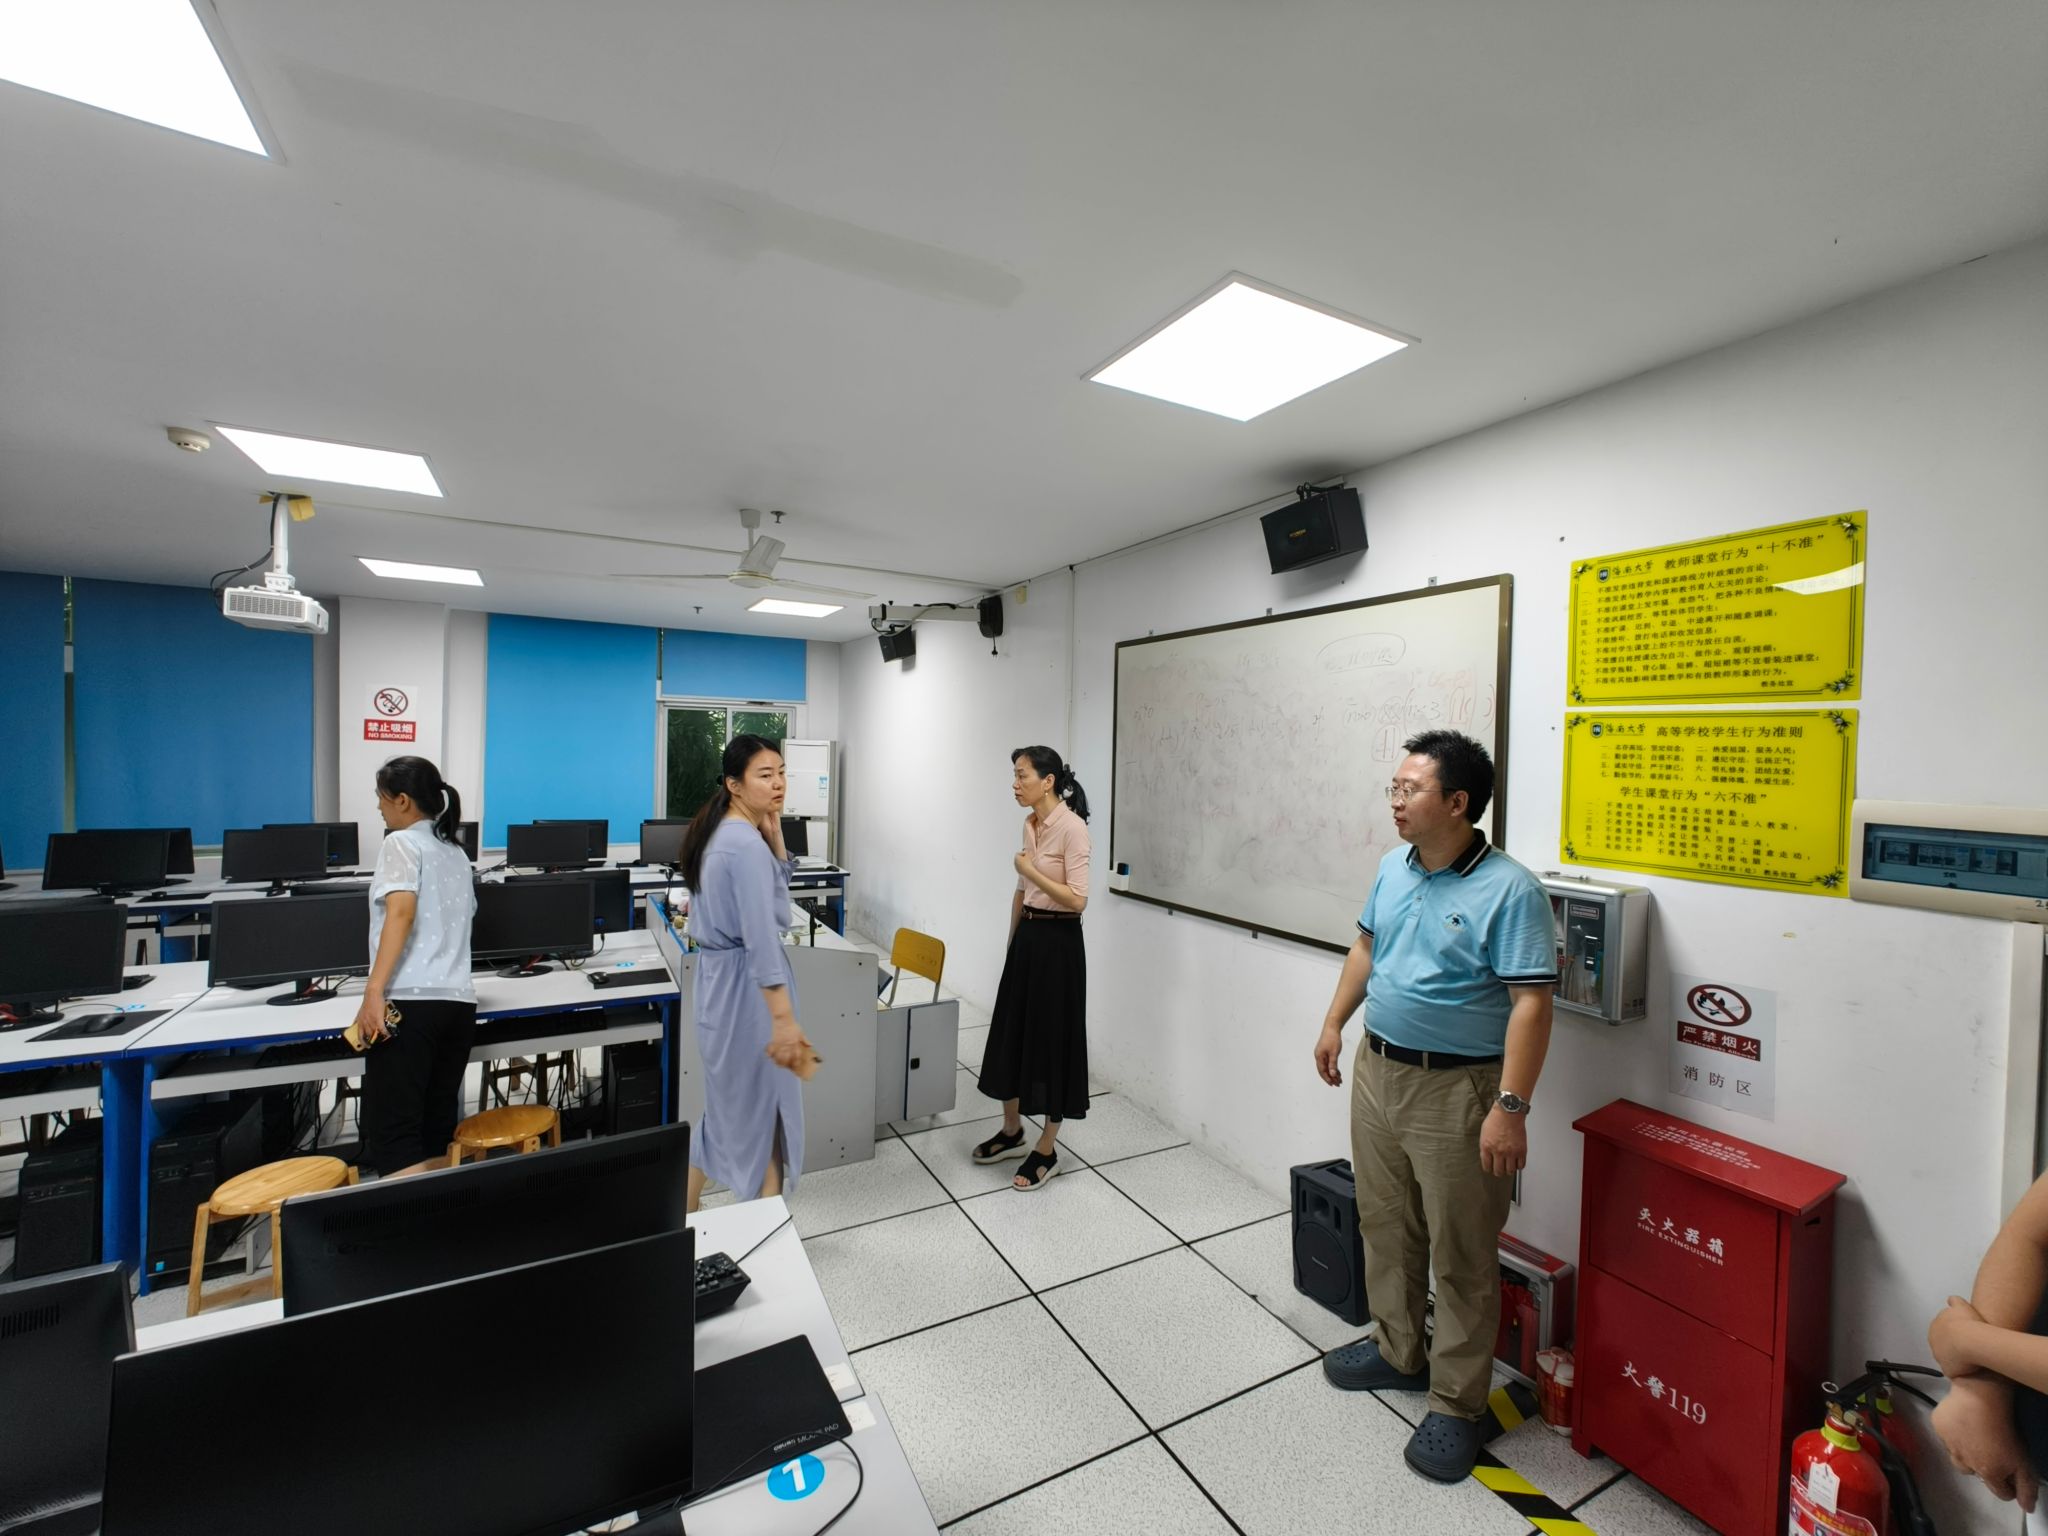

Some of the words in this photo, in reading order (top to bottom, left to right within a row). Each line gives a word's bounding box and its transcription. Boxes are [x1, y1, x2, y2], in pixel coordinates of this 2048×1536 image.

[1656, 725, 1803, 738] 高等学校学生行为准则
[1683, 1025, 1758, 1054] 严禁烟火
[1683, 1065, 1752, 1097] 消防区
[1637, 1222, 1656, 1235] FIRE
[1658, 1232, 1724, 1266] EXTINGUISHER
[1638, 1207, 1724, 1258] 灭火器箱
[782, 1457, 807, 1493] 1
